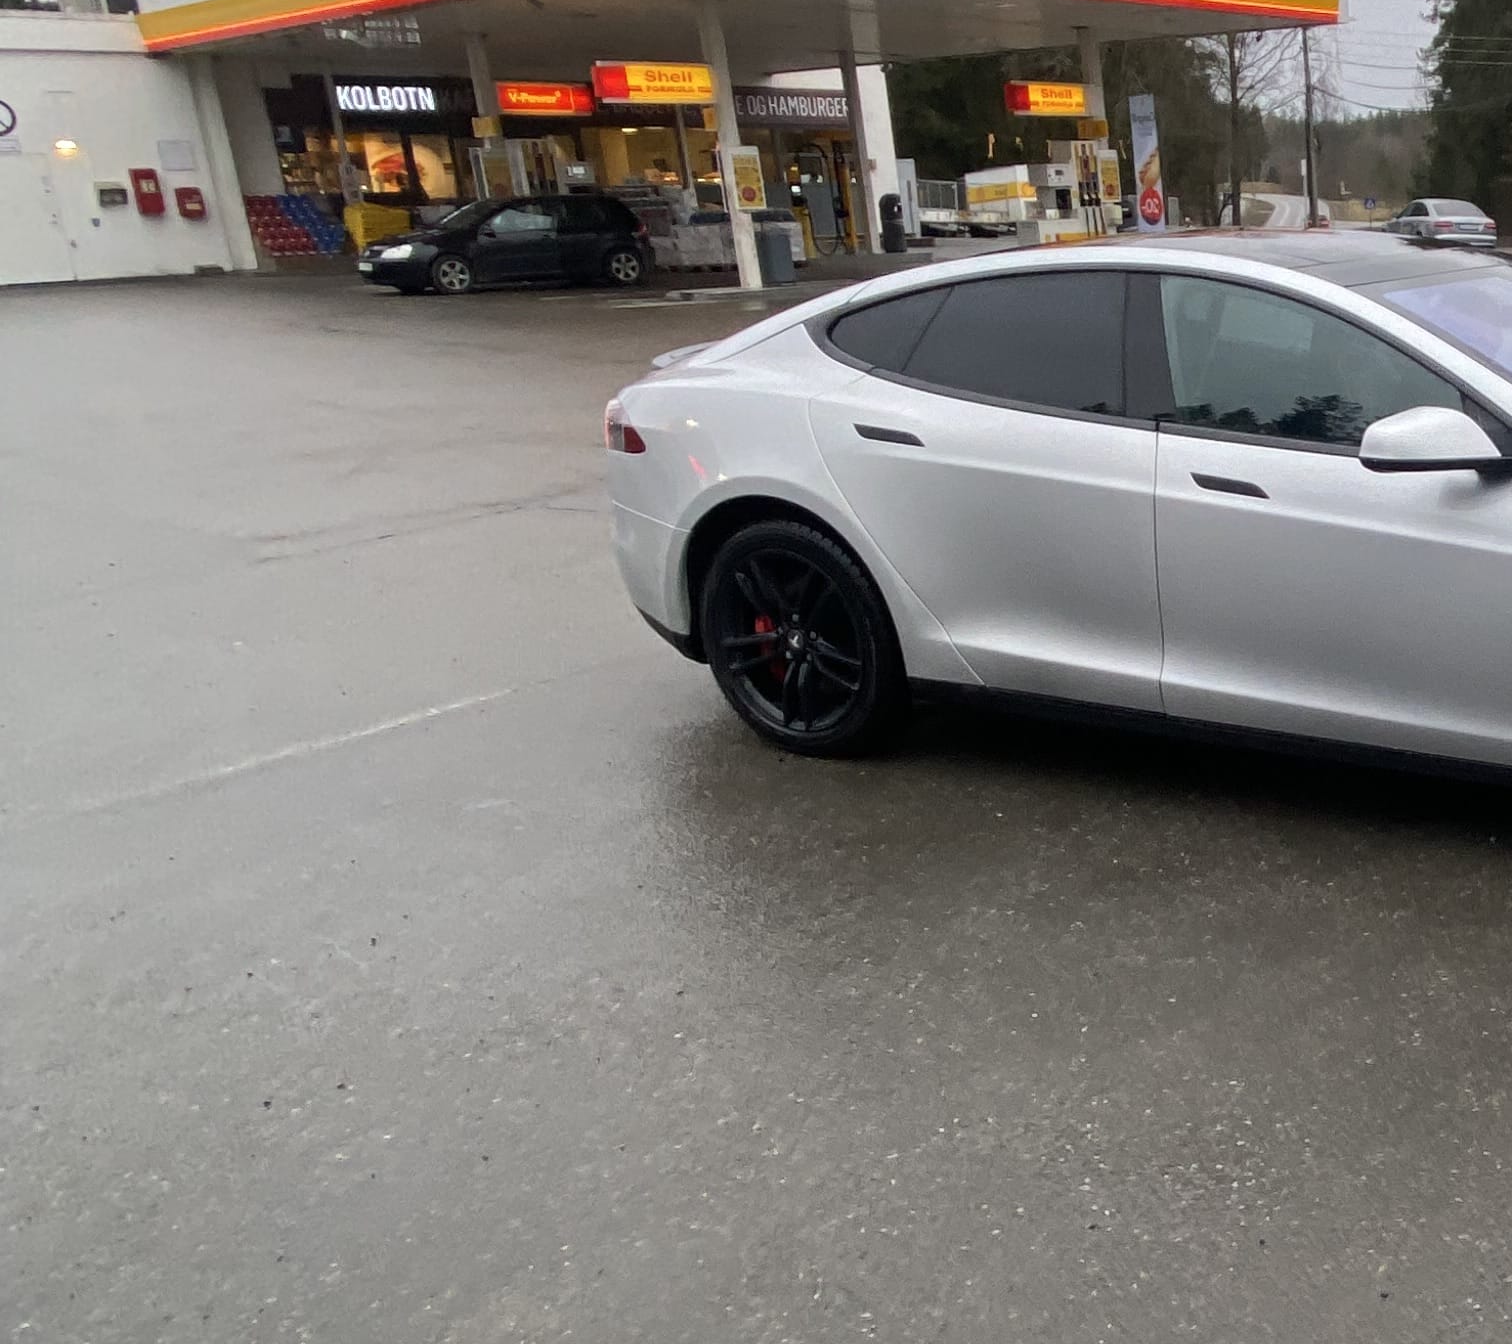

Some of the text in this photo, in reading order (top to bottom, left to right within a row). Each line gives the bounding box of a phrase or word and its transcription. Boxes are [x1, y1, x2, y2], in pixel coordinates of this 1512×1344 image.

[644, 70, 692, 83] Shell
[336, 86, 435, 111] KOLBOTN
[1041, 88, 1073, 99] Shell
[746, 96, 767, 116] OG
